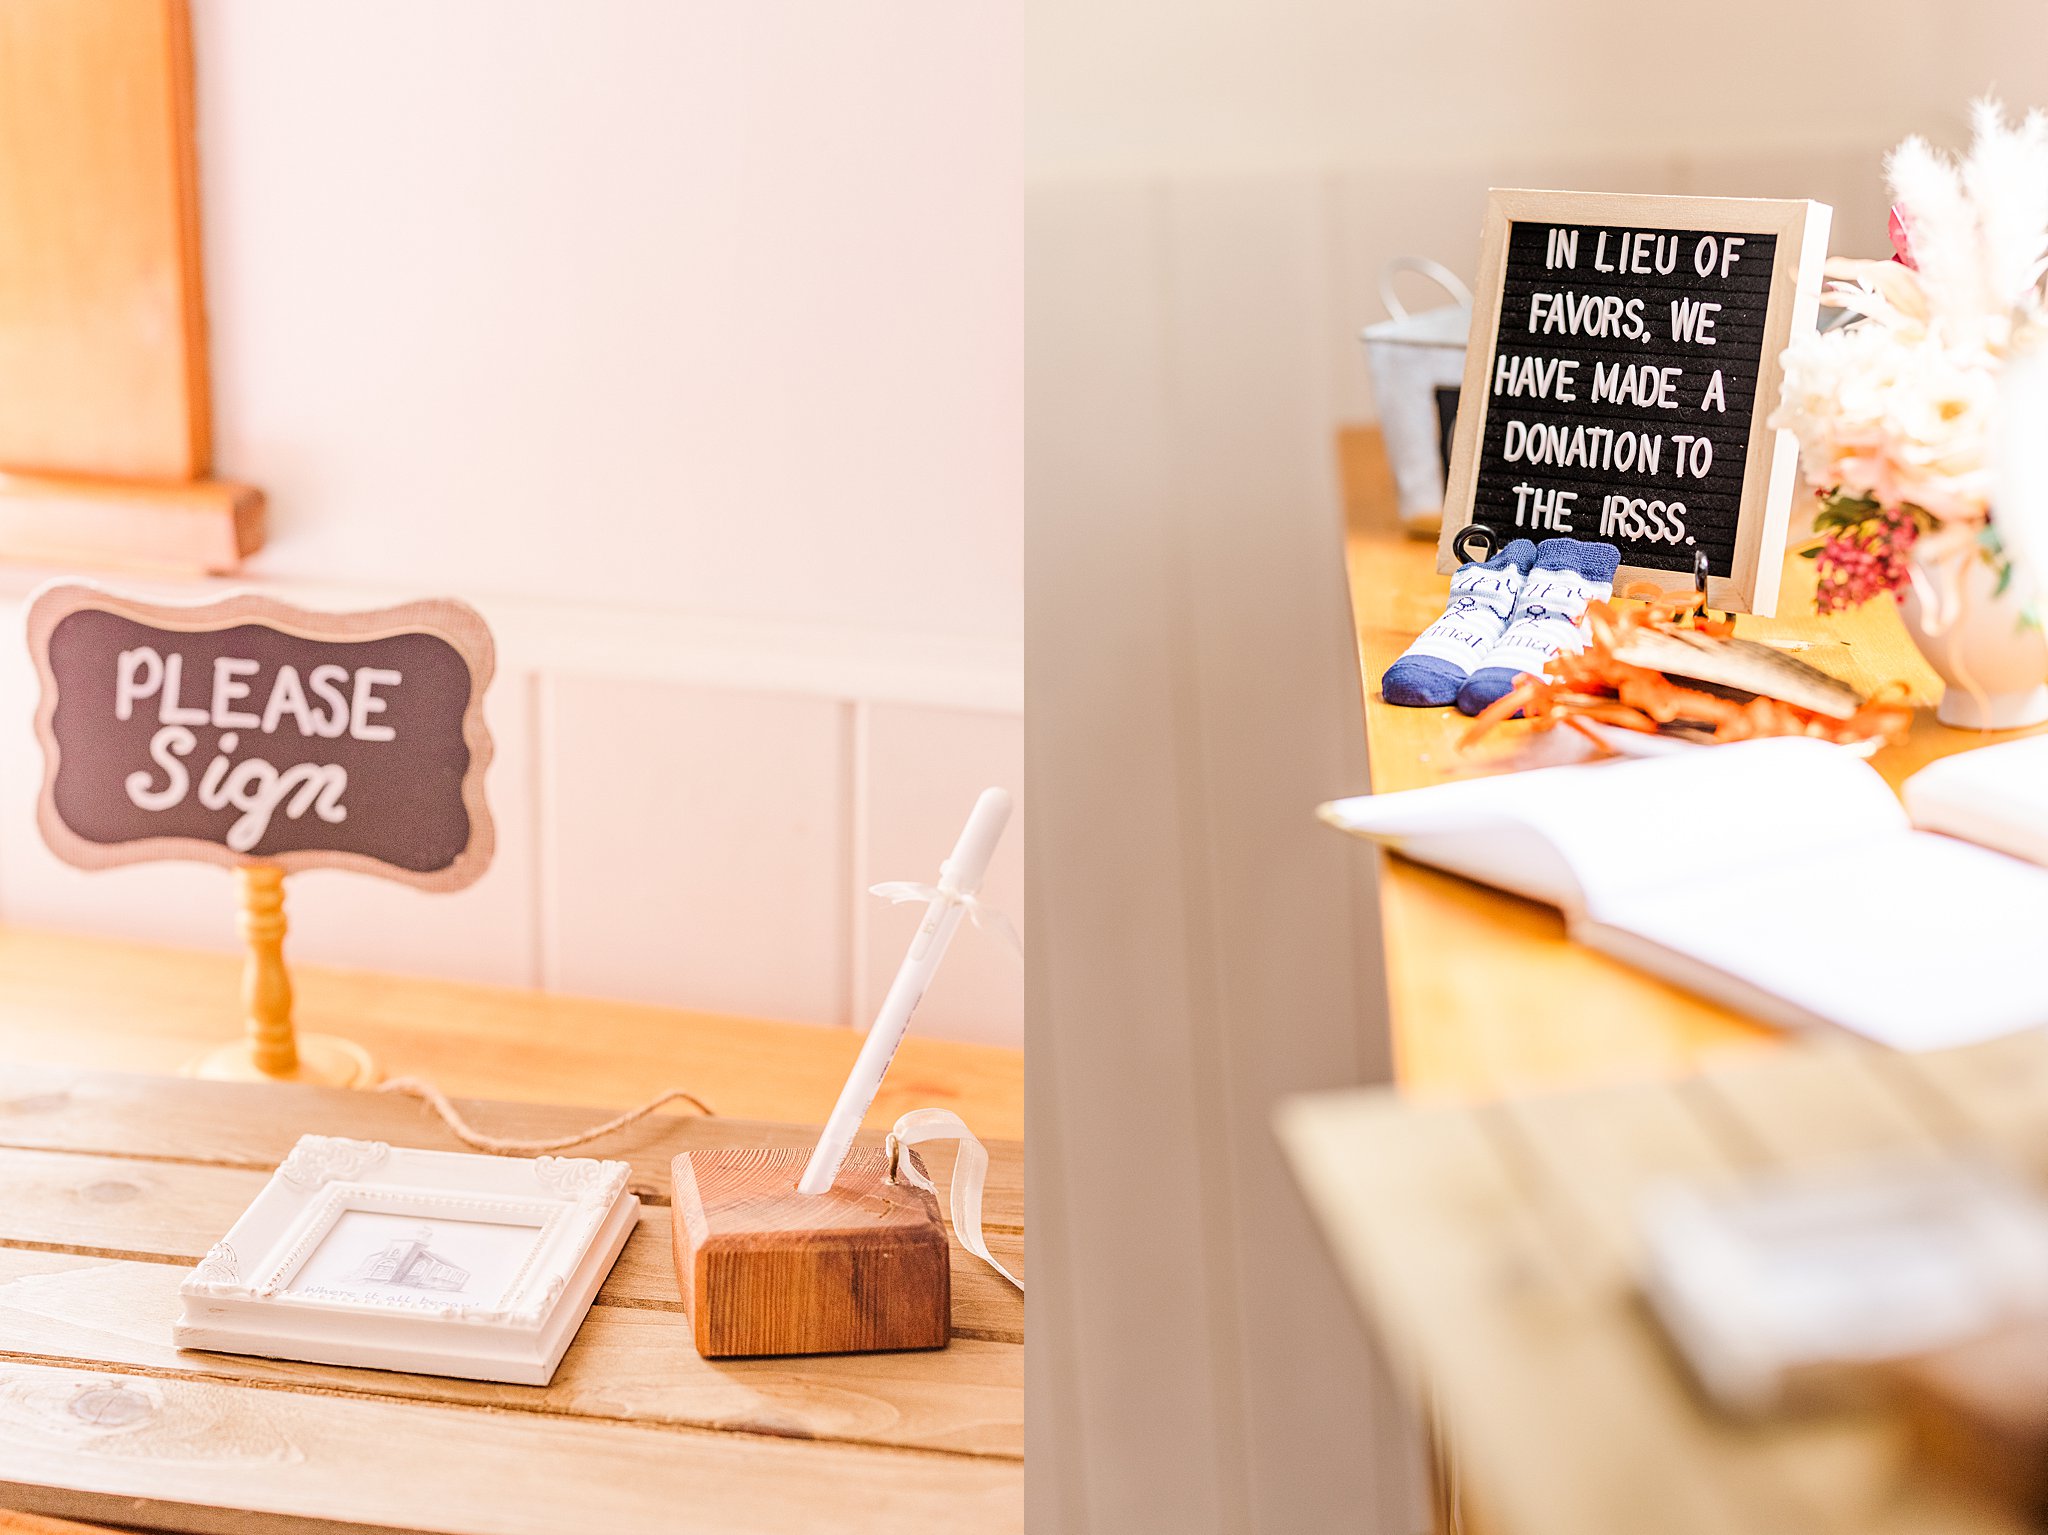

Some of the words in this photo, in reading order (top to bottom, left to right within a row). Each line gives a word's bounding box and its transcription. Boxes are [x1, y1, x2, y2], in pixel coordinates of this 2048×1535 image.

[1546, 227, 1580, 270] IN
[1594, 230, 1679, 275] LIEU
[1694, 235, 1746, 279] OF
[1528, 291, 1652, 344] FAVORS,
[1670, 296, 1723, 345] WE
[1494, 354, 1580, 403] HAVE
[1590, 361, 1683, 409] MADE
[1700, 369, 1727, 413] A
[1503, 420, 1662, 476] DONATION
[1671, 434, 1713, 479] TO
[1512, 481, 1579, 532] THE
[1599, 494, 1697, 546] IRSSS.
[115, 646, 402, 742] PLEASE
[124, 725, 348, 852] Sign
[304, 1286, 356, 1298] Where
[365, 1291, 379, 1300] it
[386, 1295, 411, 1304] all
